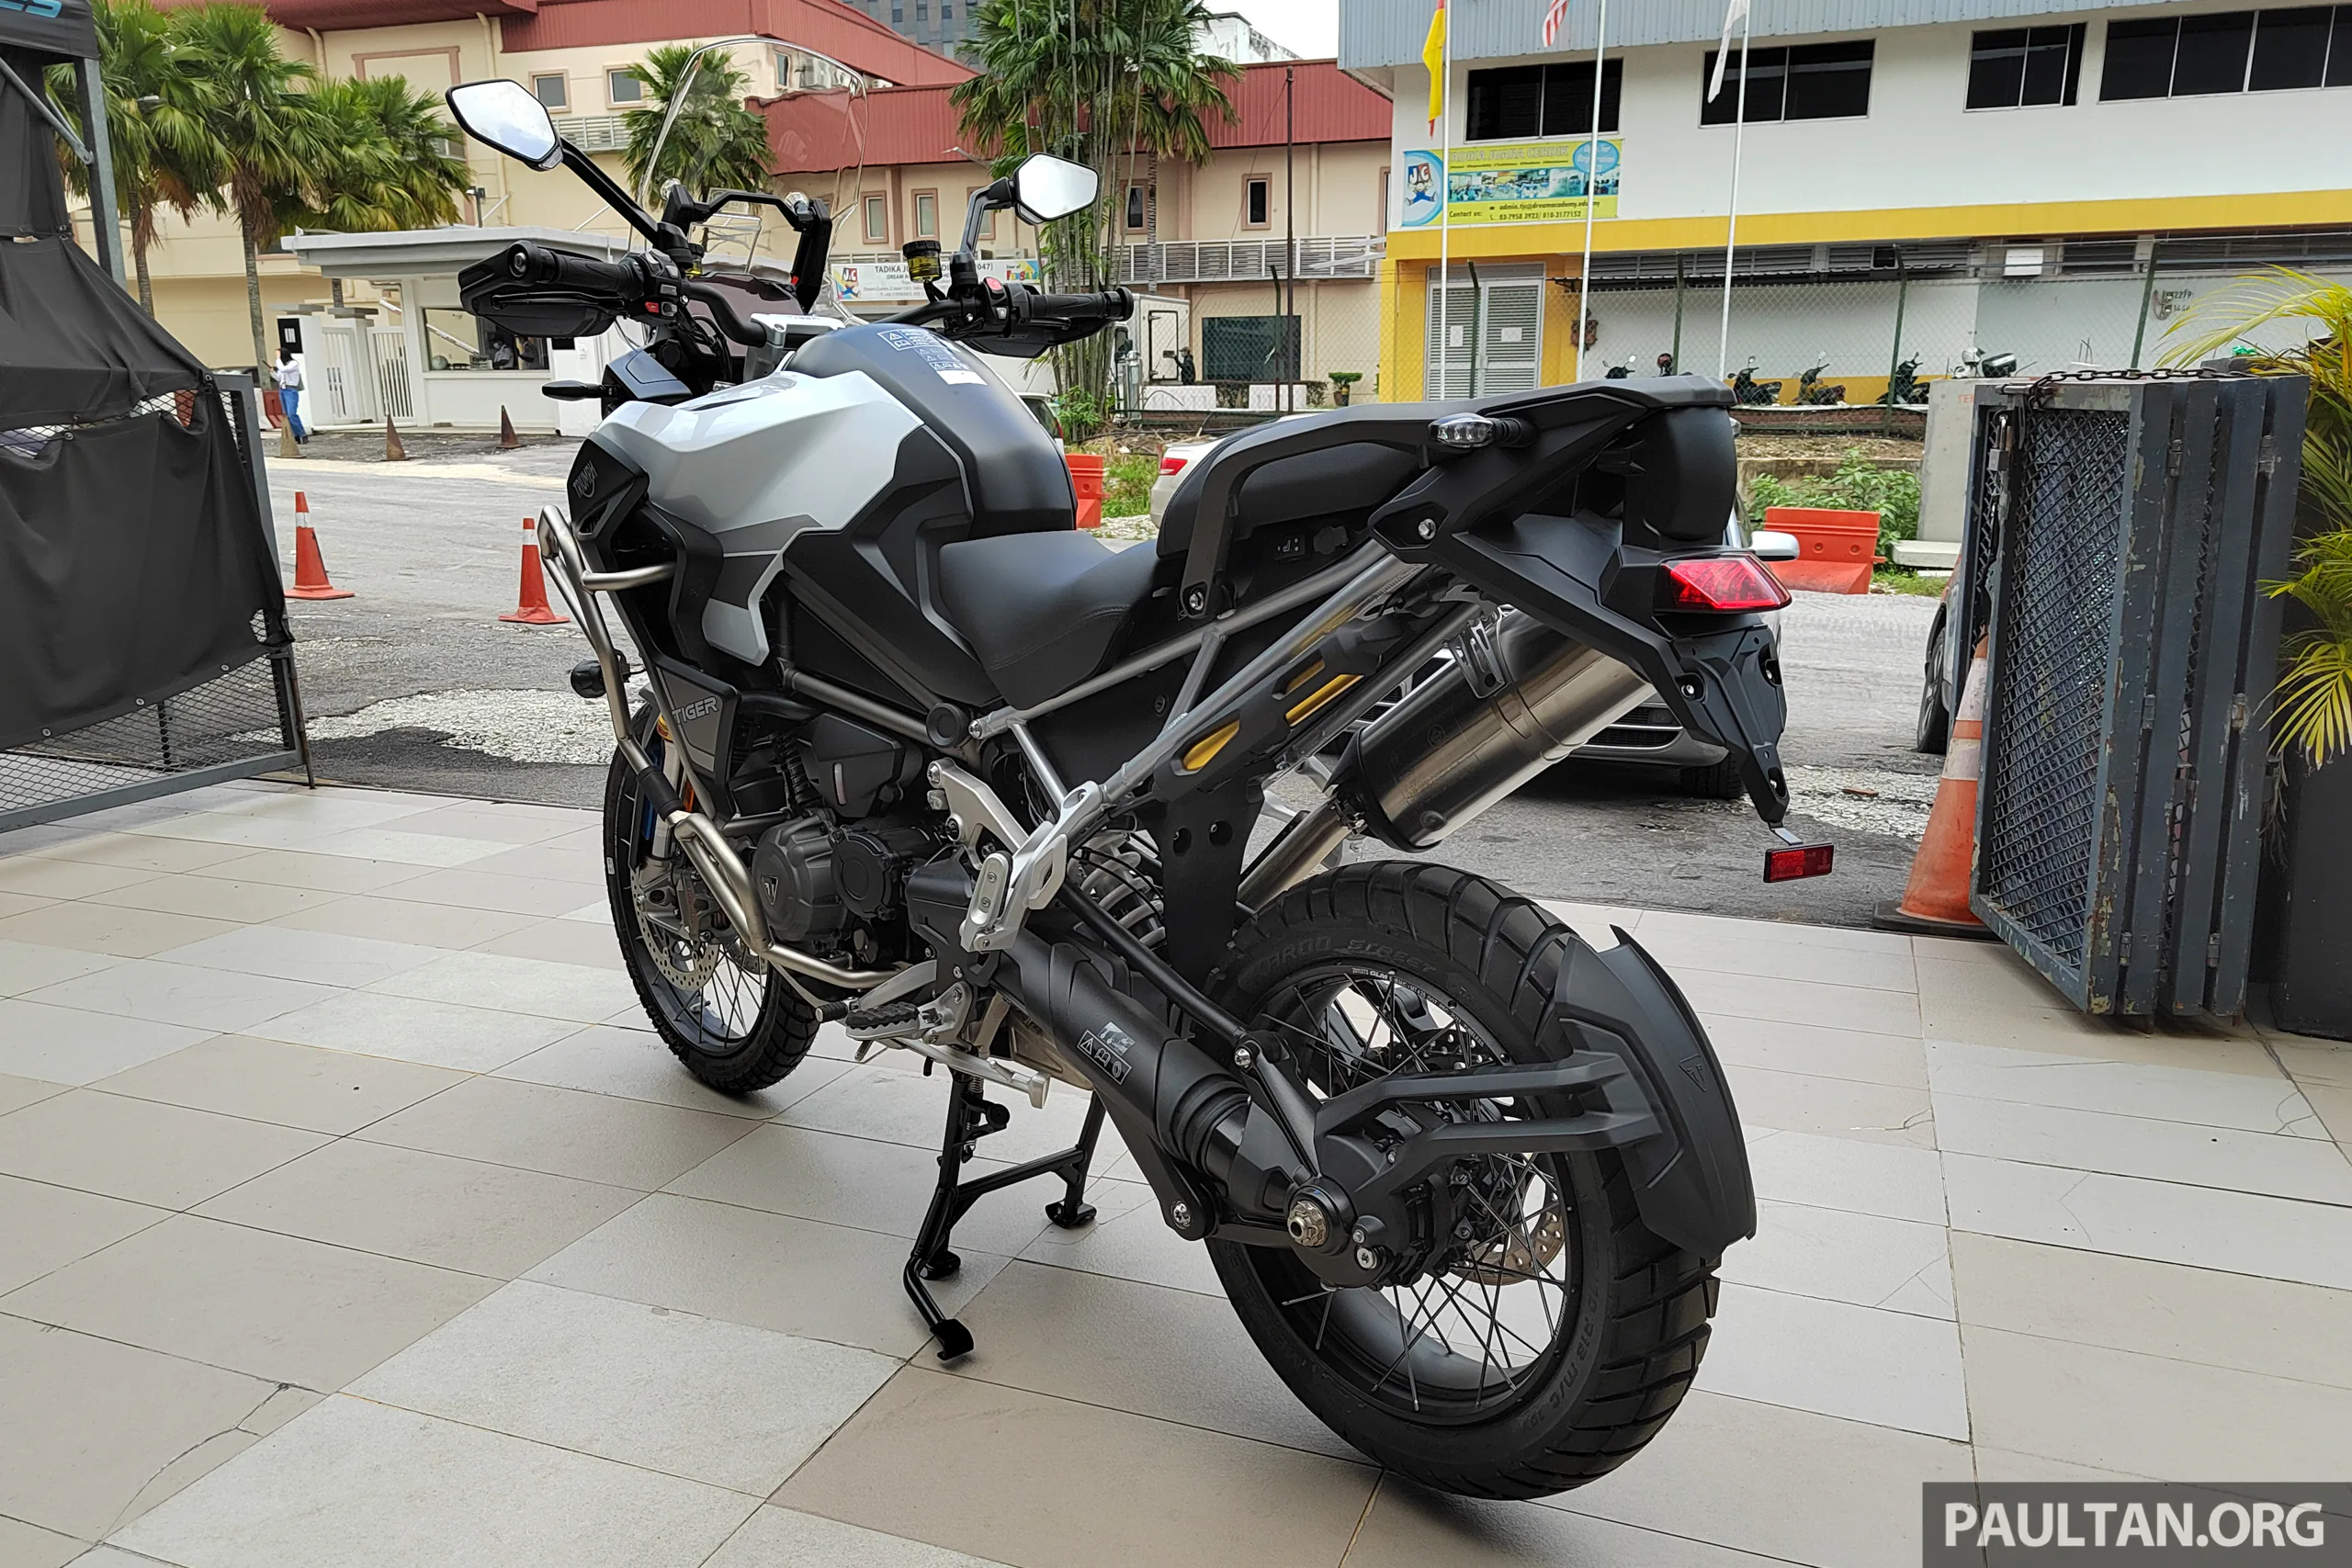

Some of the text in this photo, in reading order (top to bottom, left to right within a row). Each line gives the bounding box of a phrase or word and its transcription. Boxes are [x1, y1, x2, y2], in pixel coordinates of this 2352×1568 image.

[875, 265, 901, 274] TADIKA
[672, 695, 719, 724] TIGER
[1347, 938, 1437, 974] STREET
